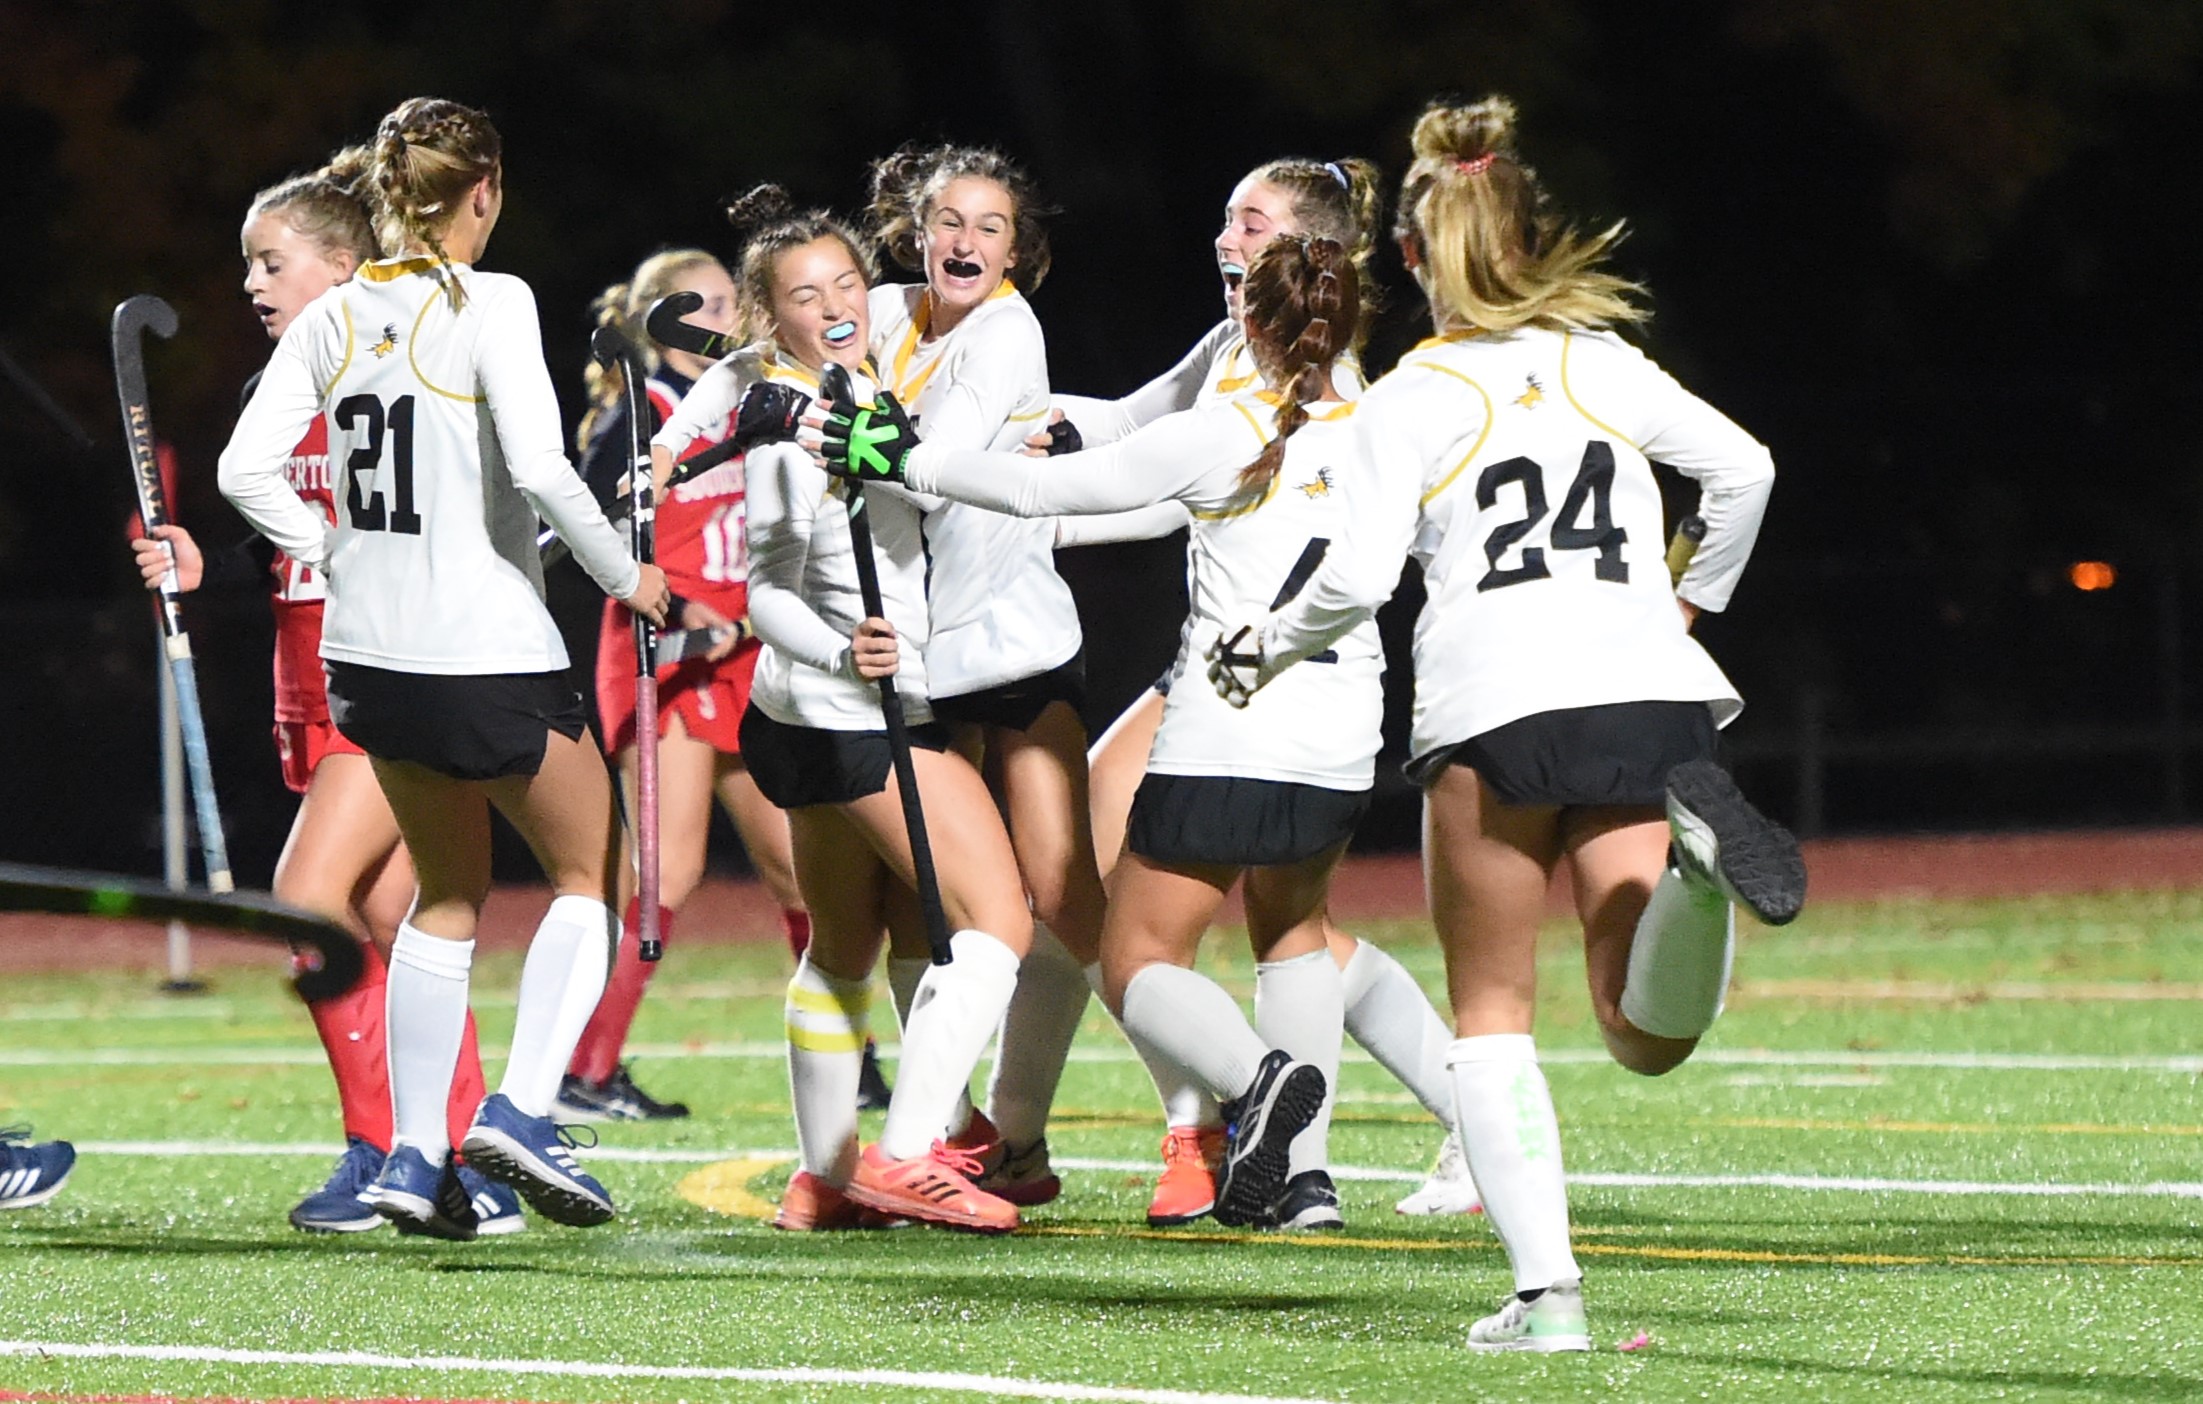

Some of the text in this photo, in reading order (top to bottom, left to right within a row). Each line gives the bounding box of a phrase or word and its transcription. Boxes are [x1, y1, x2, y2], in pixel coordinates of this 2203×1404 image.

[129, 404, 162, 519] RITUAL
[335, 393, 421, 535] 21
[1476, 440, 1630, 593] 24
